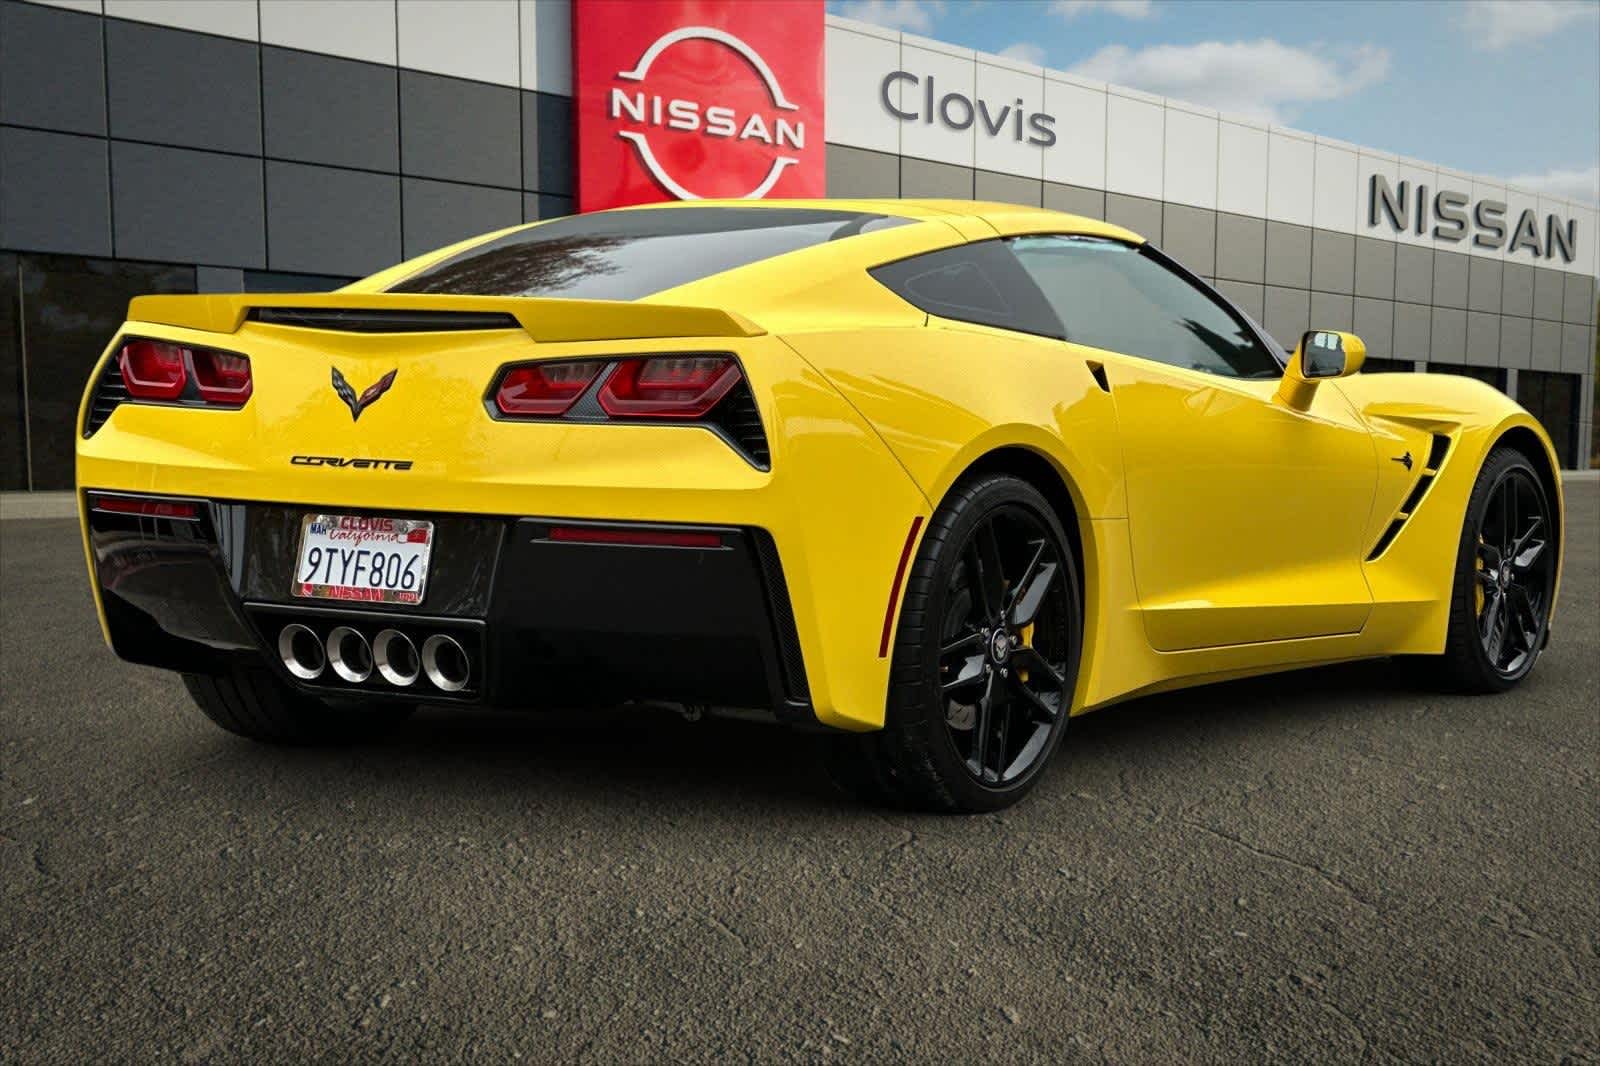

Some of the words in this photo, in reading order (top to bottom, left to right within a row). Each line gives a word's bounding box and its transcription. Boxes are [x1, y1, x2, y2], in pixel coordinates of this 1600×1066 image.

[611, 88, 804, 149] NISSAN
[881, 70, 1057, 147] Clovis
[1368, 173, 1577, 263] NISSAN
[291, 456, 413, 470] CORVETTE
[329, 529, 400, 546] California
[340, 516, 393, 531] CLOVIS
[303, 547, 419, 589] 9TYF806
